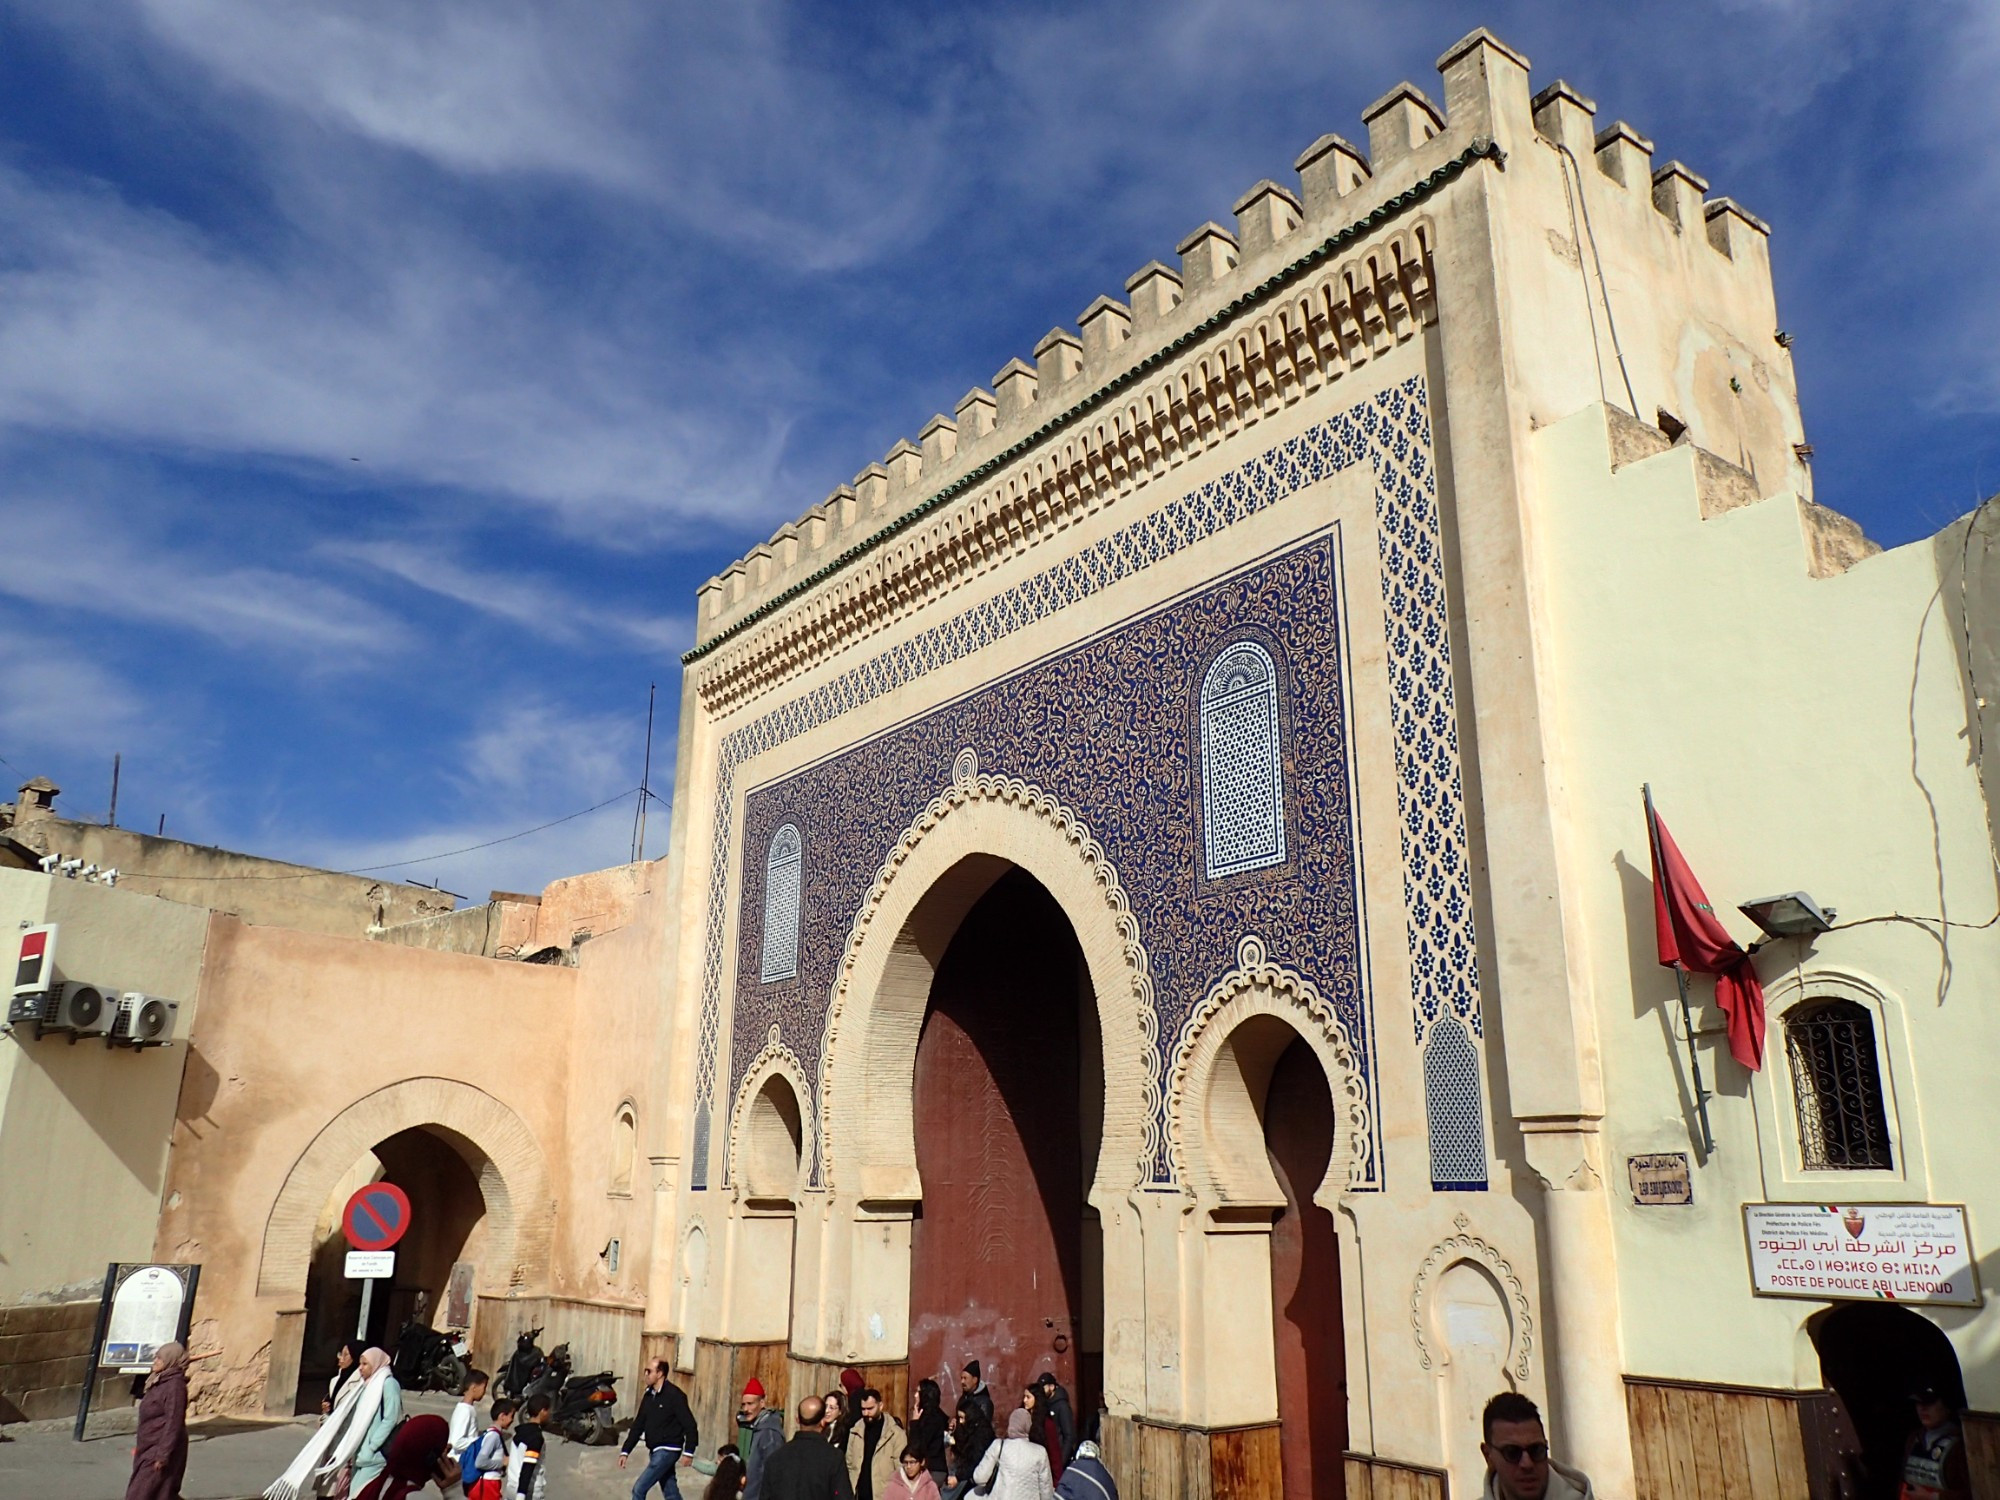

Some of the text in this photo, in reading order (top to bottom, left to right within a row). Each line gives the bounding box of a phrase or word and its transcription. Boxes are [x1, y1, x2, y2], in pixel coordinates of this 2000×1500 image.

[1758, 1235, 1956, 1259] مركز الشرطة أبي الجنود
[1771, 1275, 1953, 1294] POSTE DE POLICE ABI LJENOUD
